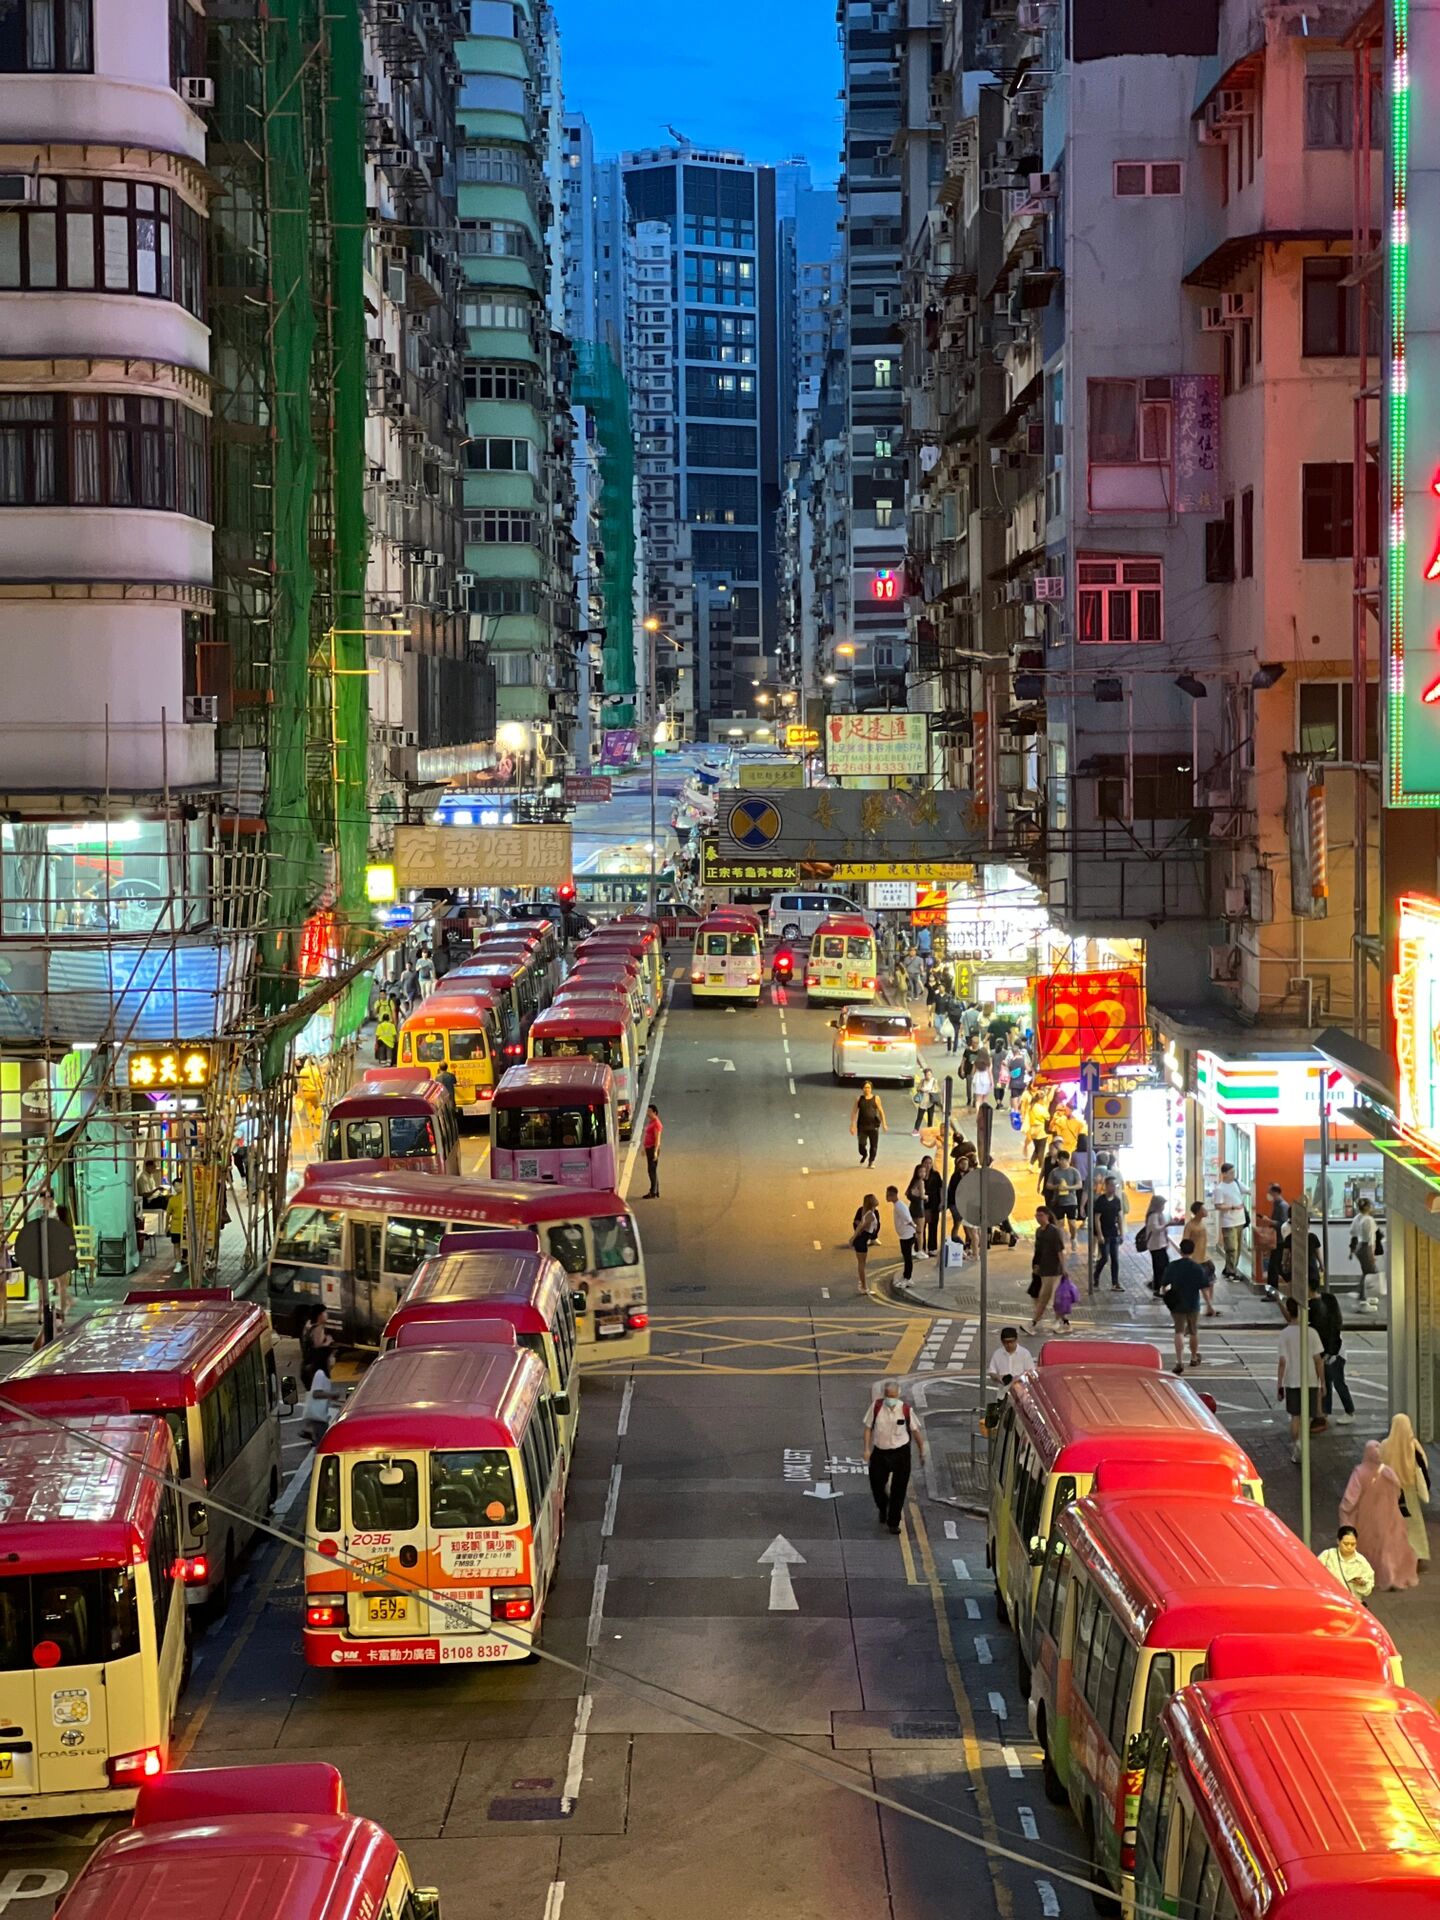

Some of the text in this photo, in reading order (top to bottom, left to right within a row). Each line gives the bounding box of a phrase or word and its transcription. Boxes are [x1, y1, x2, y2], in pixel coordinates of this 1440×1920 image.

[1098, 1121, 1128, 1130] 24 hrs
[1101, 1131, 1124, 1142] 全日
[783, 1448, 812, 1482] LOOK LEFT
[380, 1599, 397, 1609] FN
[370, 1609, 406, 1620] 3373
[442, 1645, 509, 1659] 8108 8387
[40, 1747, 106, 1759] COASTER
